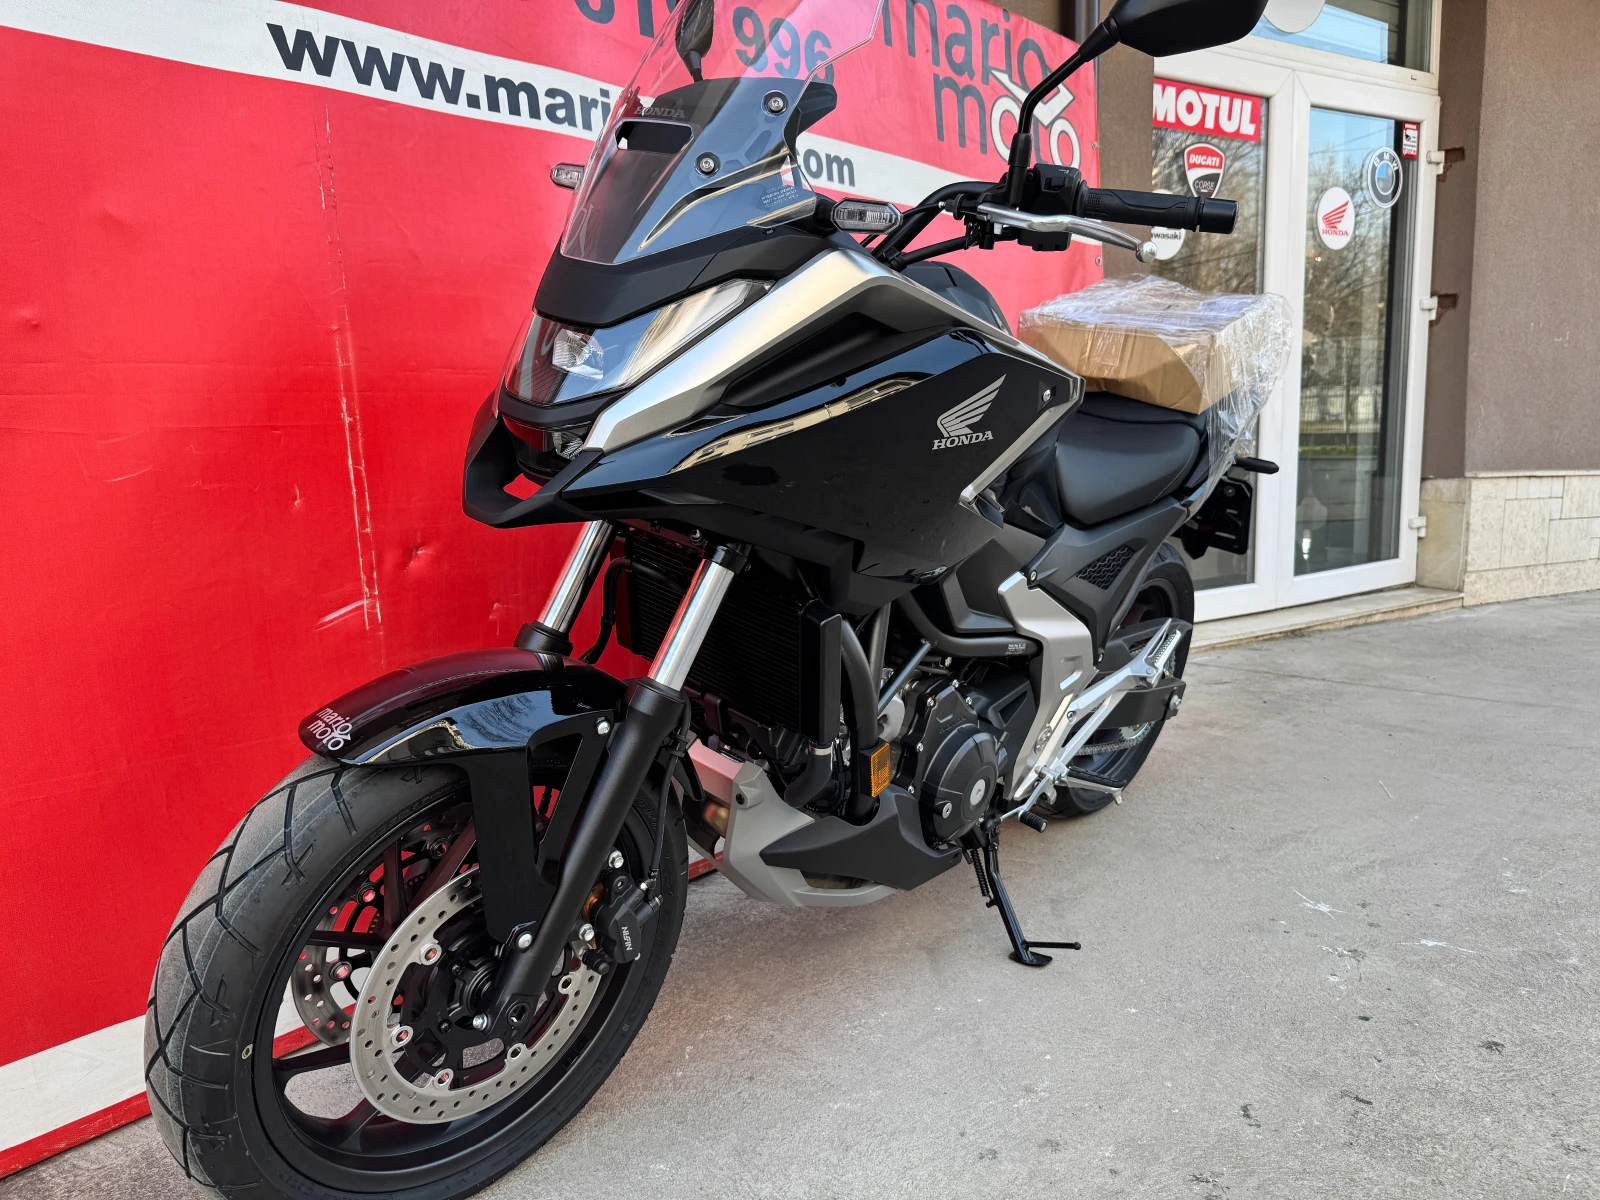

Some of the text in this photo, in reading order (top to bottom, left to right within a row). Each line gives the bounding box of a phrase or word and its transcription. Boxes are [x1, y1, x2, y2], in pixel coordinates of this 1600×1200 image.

[633, 106, 686, 119] HONDA
[1153, 83, 1257, 136] MOTUL
[1189, 153, 1220, 168] DUCATI
[1373, 151, 1400, 171] BMW
[1194, 180, 1215, 191] CORSE
[1322, 229, 1349, 237] HONDA
[931, 430, 994, 451] HONDA
[316, 707, 353, 735] mario
[307, 719, 346, 751] moto
